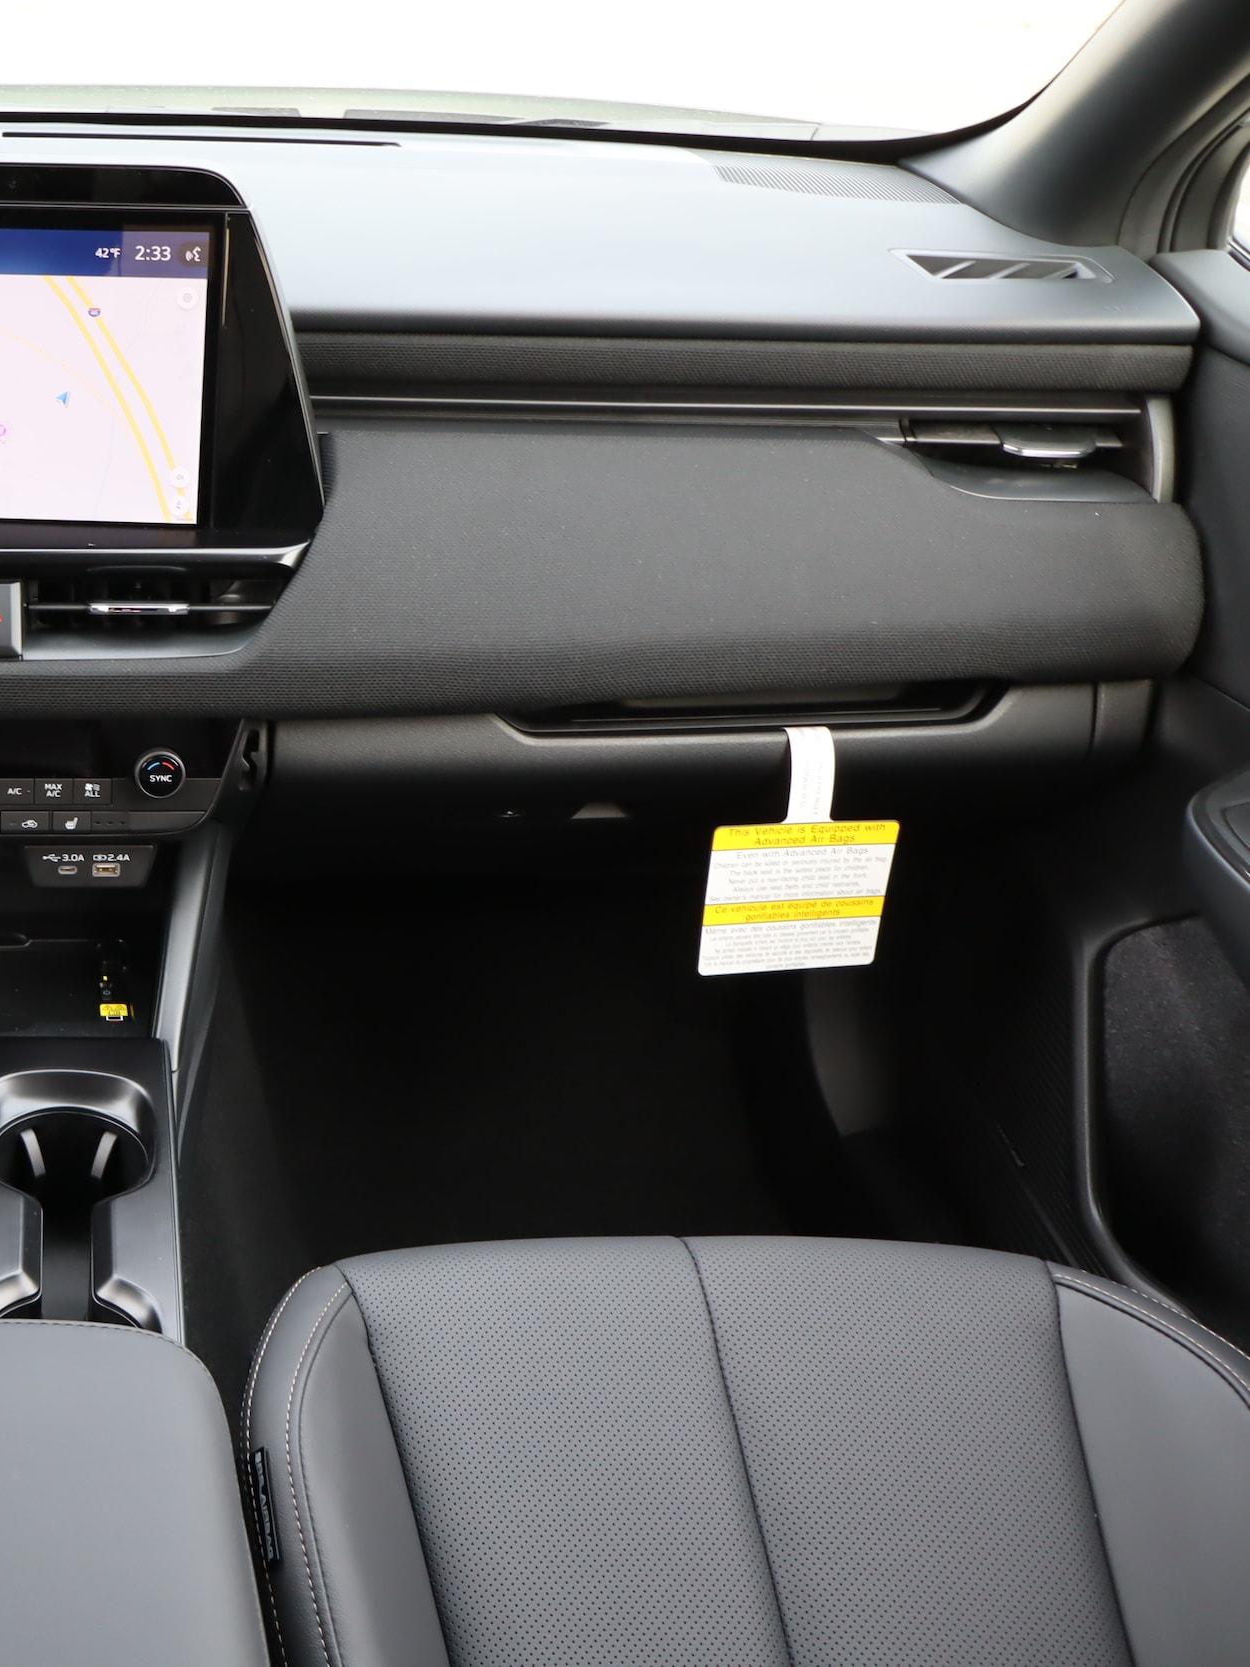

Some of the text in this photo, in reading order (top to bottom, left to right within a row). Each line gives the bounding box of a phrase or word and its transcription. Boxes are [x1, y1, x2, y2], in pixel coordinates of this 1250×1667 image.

[135, 245, 172, 261] 2:33
[7, 787, 22, 795] A/C
[45, 790, 61, 798] A/C
[84, 790, 100, 798] ALL
[729, 828, 750, 837] This
[755, 826, 793, 835] Vehicle
[811, 823, 860, 834] Equipped
[865, 823, 885, 831] with
[754, 834, 855, 846] Advanced Air Bags
[61, 854, 85, 862] 3.0A
[107, 854, 130, 862] 2.4A
[737, 851, 758, 859] Even
[784, 848, 827, 857] Advanced
[847, 847, 869, 855] Bags
[715, 905, 727, 914] Ce
[836, 898, 873, 907] coussins
